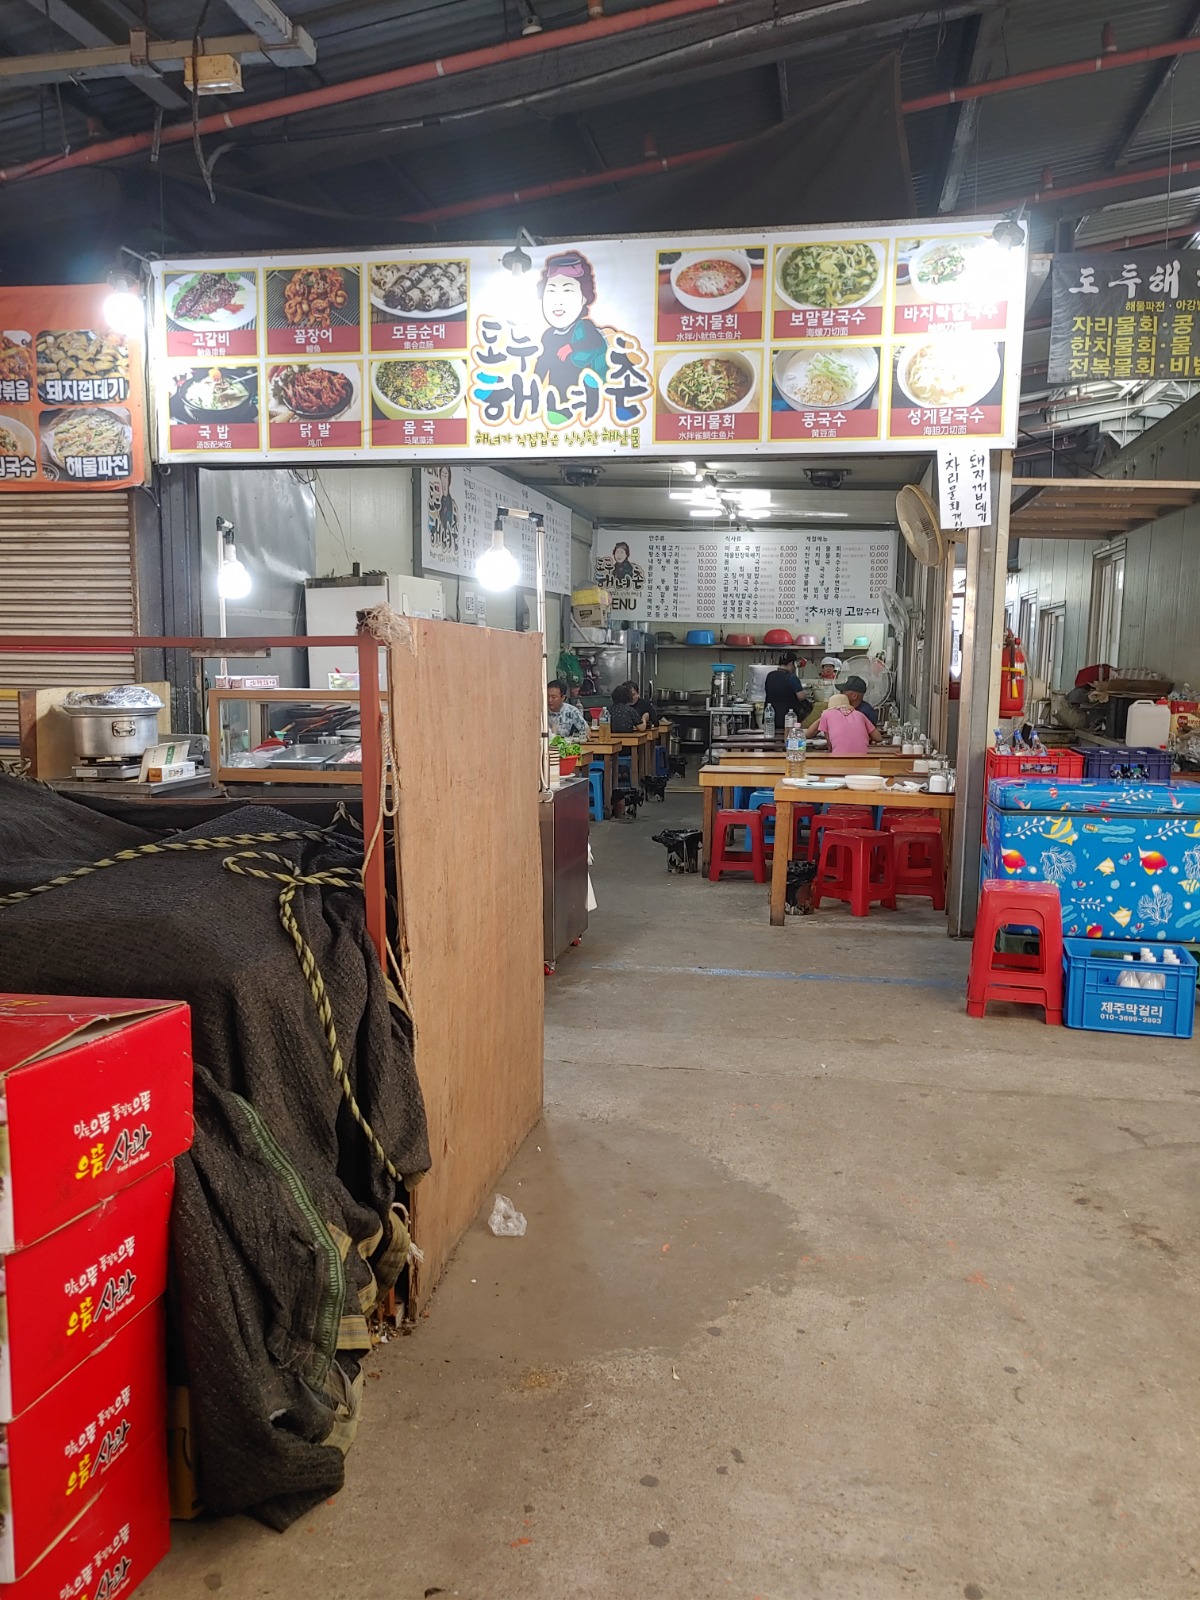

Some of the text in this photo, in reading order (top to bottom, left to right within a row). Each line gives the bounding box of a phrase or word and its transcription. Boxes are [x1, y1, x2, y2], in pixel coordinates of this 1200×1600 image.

[680, 314, 738, 331] 한치물회
[790, 308, 866, 327] 보말칼국수
[192, 332, 230, 346] 고갈비
[294, 328, 332, 344] 꼼장어
[392, 324, 446, 340] 모듬순대
[0, 380, 30, 401] 볶음
[45, 377, 126, 402] 돼지껍데기
[678, 414, 736, 430] 자리물회
[802, 412, 847, 428] 콩국수
[908, 406, 986, 426] 성게칼국수
[475, 432, 512, 446] 해녀가
[564, 431, 598, 446] 싱싱한
[601, 428, 641, 448] 해산물
[65, 455, 130, 478] 해물파전
[612, 598, 637, 610] ENU
[845, 607, 879, 616] 고맙수다
[1101, 1002, 1162, 1018] 제주막걸리
